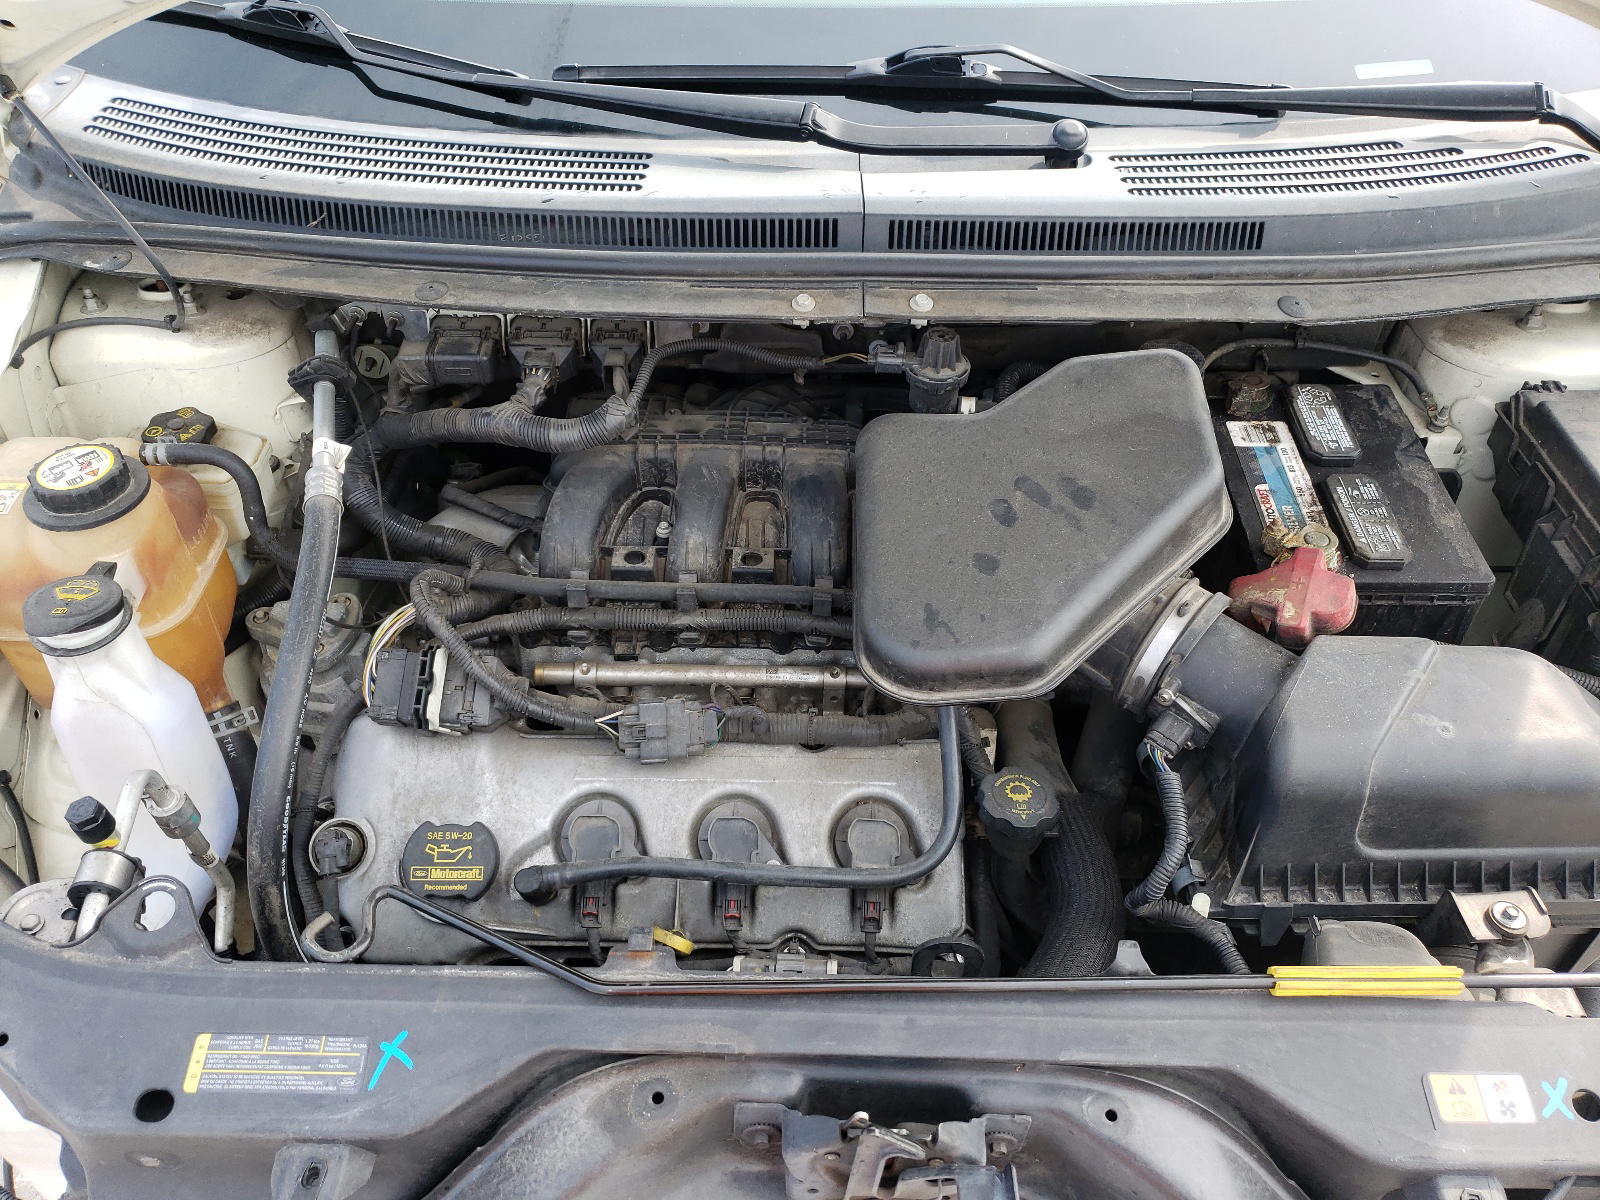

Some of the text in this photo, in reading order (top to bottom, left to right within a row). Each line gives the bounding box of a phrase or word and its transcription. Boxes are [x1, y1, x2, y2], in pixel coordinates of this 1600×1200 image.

[223, 736, 238, 759] TNK
[427, 831, 473, 840] SAE 5W-20
[430, 868, 482, 879] Motorcraft
